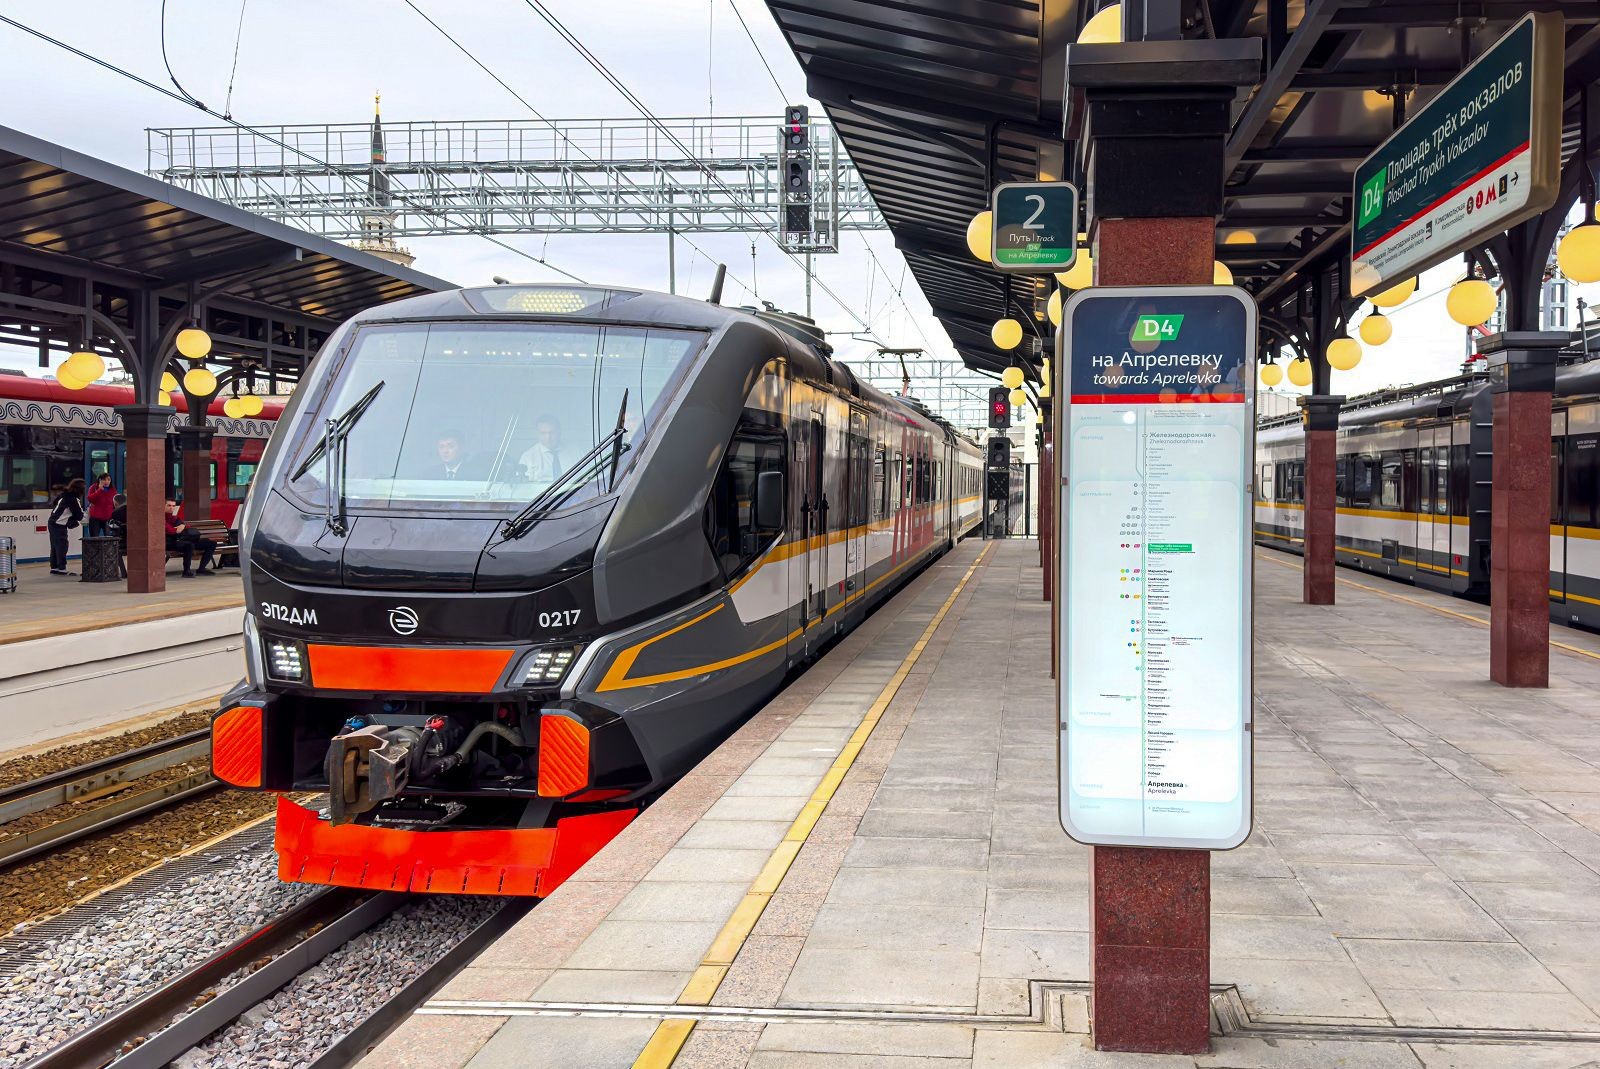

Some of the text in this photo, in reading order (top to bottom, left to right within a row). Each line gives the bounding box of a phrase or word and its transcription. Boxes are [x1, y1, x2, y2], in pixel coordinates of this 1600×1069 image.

[1387, 61, 1523, 183] Площадь трёх вокзалов
[1386, 120, 1489, 208] Ploschad Tryokh Vokzalov
[1364, 183, 1381, 217] D4
[1023, 194, 1045, 230] 2
[1009, 233, 1055, 244] Путь Track
[1018, 251, 1058, 260] Апрелевку
[1143, 319, 1175, 337] D4
[1092, 351, 1224, 371] на Апрелевку
[1093, 370, 1222, 387] towards Aprelevka
[261, 601, 318, 626] ЭП2ДМ
[538, 609, 581, 628] 0217
[1147, 780, 1184, 789] Апрелевка
